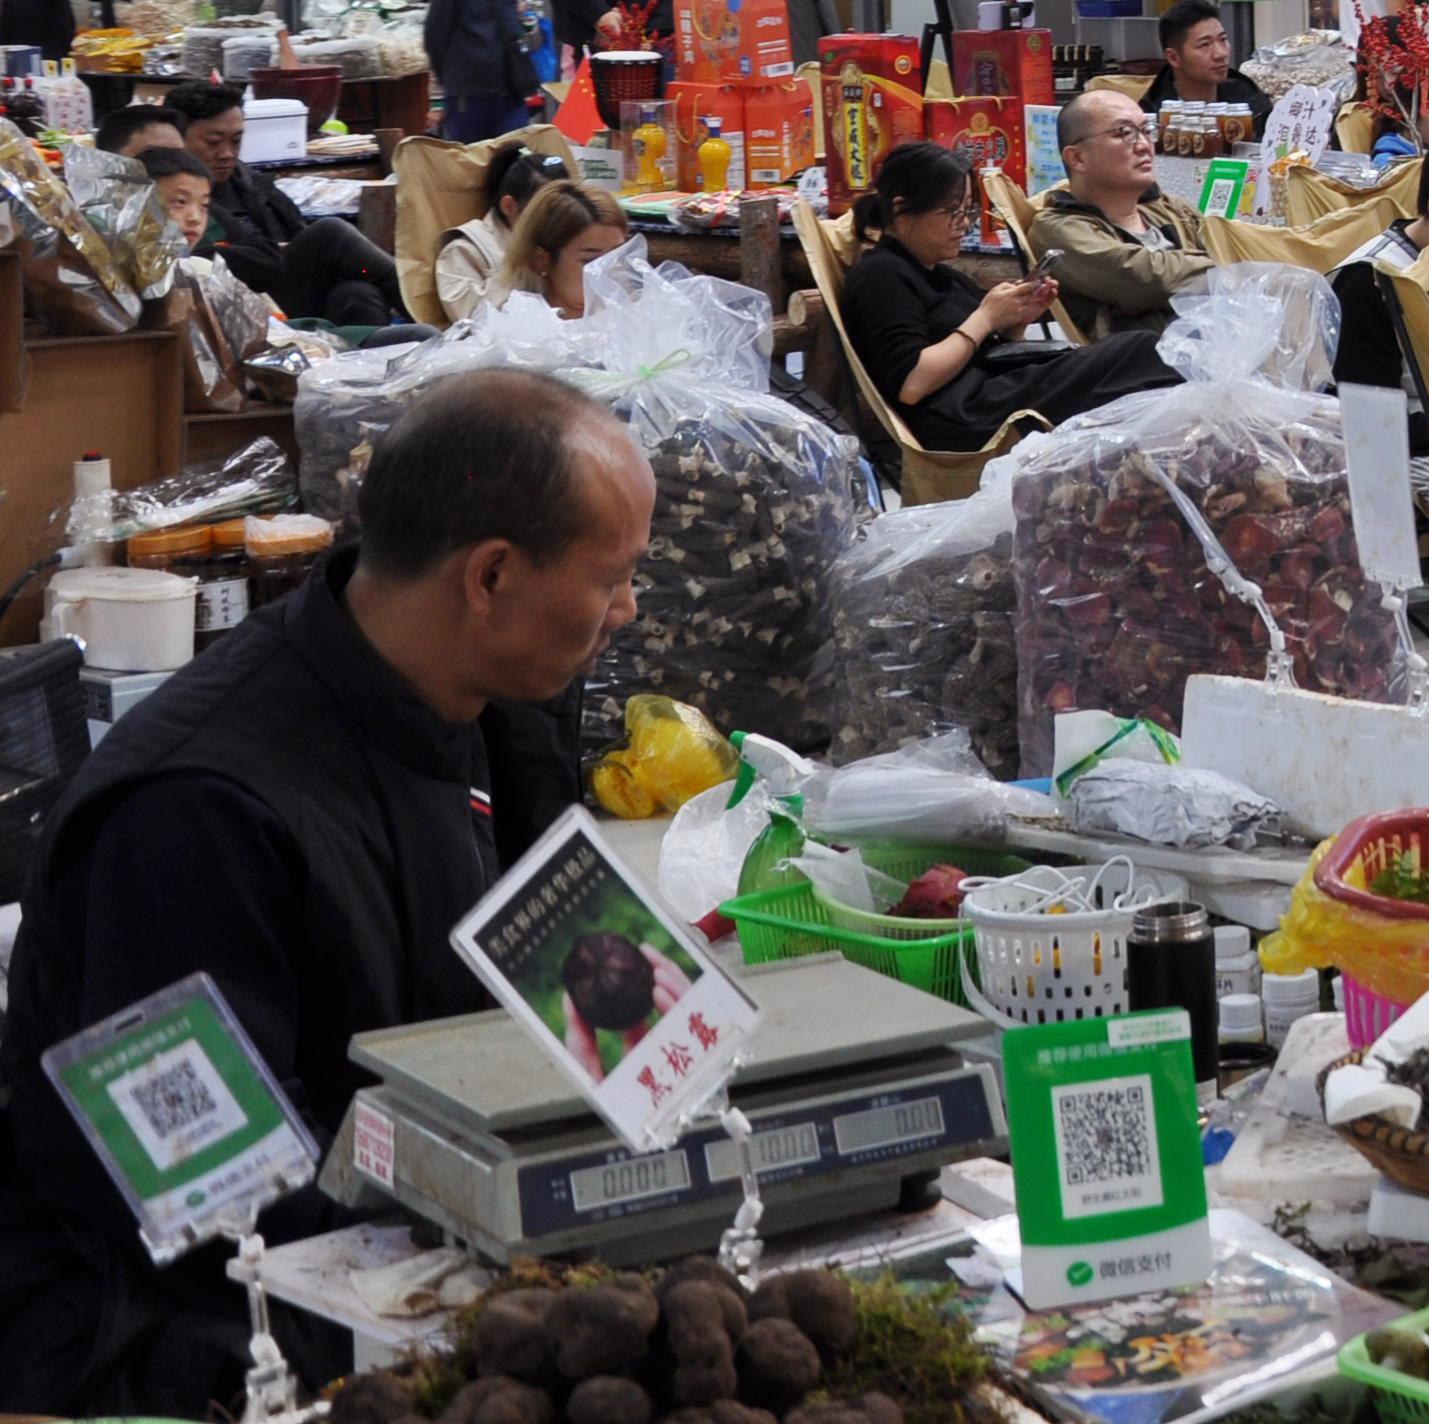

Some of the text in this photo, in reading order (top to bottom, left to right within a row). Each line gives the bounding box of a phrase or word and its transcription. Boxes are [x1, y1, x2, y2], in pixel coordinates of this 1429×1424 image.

[636, 1011, 719, 1109] 黑松露
[1099, 1251, 1173, 1282] 微信支付
